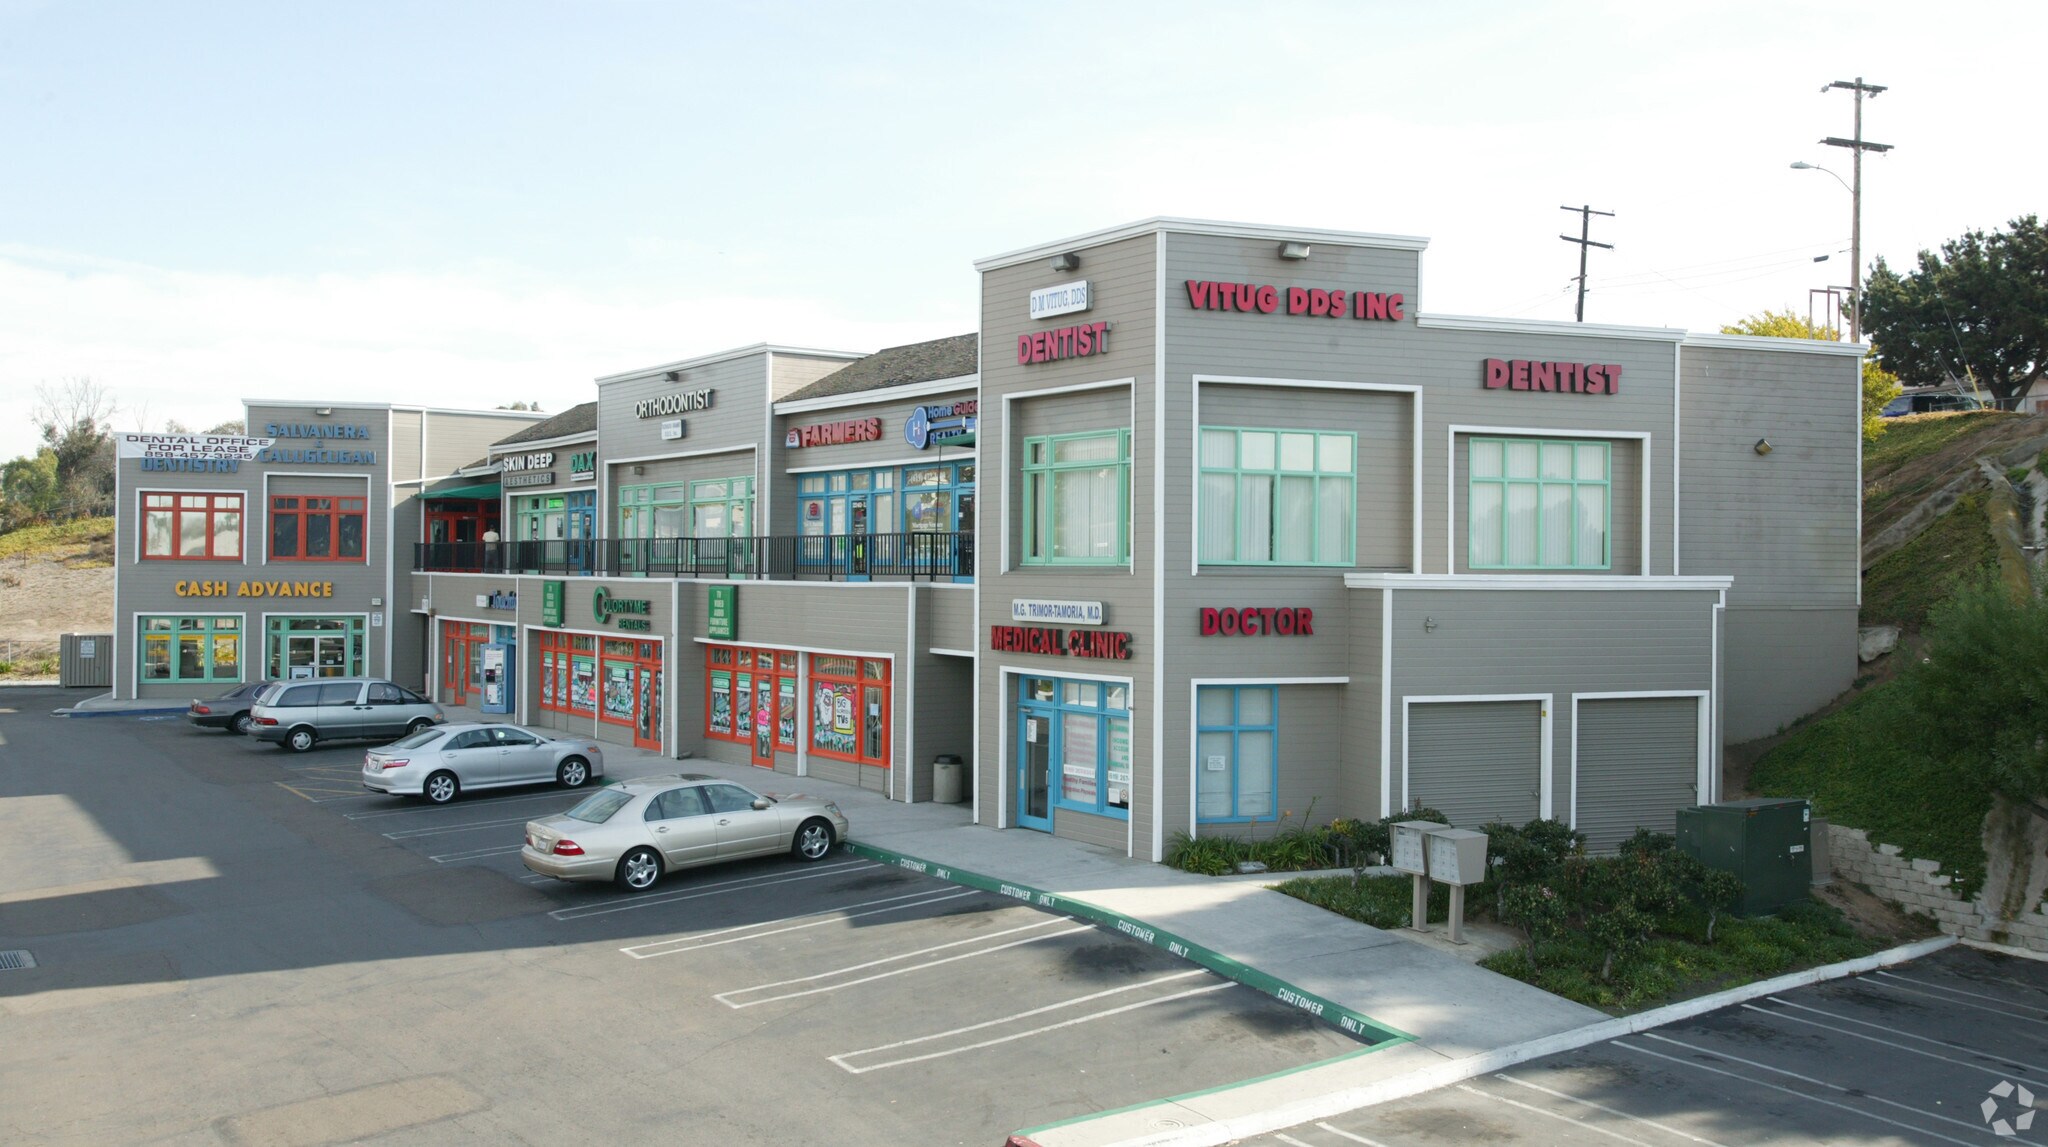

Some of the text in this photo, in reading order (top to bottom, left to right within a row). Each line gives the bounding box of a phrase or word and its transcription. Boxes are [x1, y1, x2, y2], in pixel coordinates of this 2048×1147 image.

[1031, 286, 1086, 313] D M VITUG, DDS
[1185, 280, 1404, 321] VITUG DDS INC
[1018, 321, 1107, 366] DENTIST
[1483, 358, 1622, 395] DENTIST
[635, 388, 712, 419] ORTHODONTIST
[928, 405, 952, 419] Home
[126, 434, 269, 447] DENTAL OFFICE
[265, 423, 370, 440] SALVANERA
[800, 417, 880, 448] FARMERS
[147, 443, 250, 454] FOR LEASE
[258, 449, 377, 465] CALUGCUGAN
[141, 457, 242, 473] DENTISTRY
[503, 452, 553, 472] SKIN DEEP
[504, 473, 550, 487] AESTHETICS
[175, 580, 333, 598] CASH ADVANCE
[593, 586, 649, 625] COLORTYME
[1013, 603, 1102, 622] M.G. TRIMOR-TAMORIA, M.D.
[618, 618, 648, 631] RENTALS
[1199, 607, 1313, 636] DOCTOR
[990, 626, 1132, 660] MEDICAL CLINIC
[836, 714, 849, 724] TVs
[900, 857, 951, 880] CUSTOMER ONLY
[1000, 884, 1055, 907] CUSTOMER ONLY
[1117, 919, 1189, 958] CUSTOMER ONLY
[1277, 988, 1366, 1036] CUSTOMER ONLY
